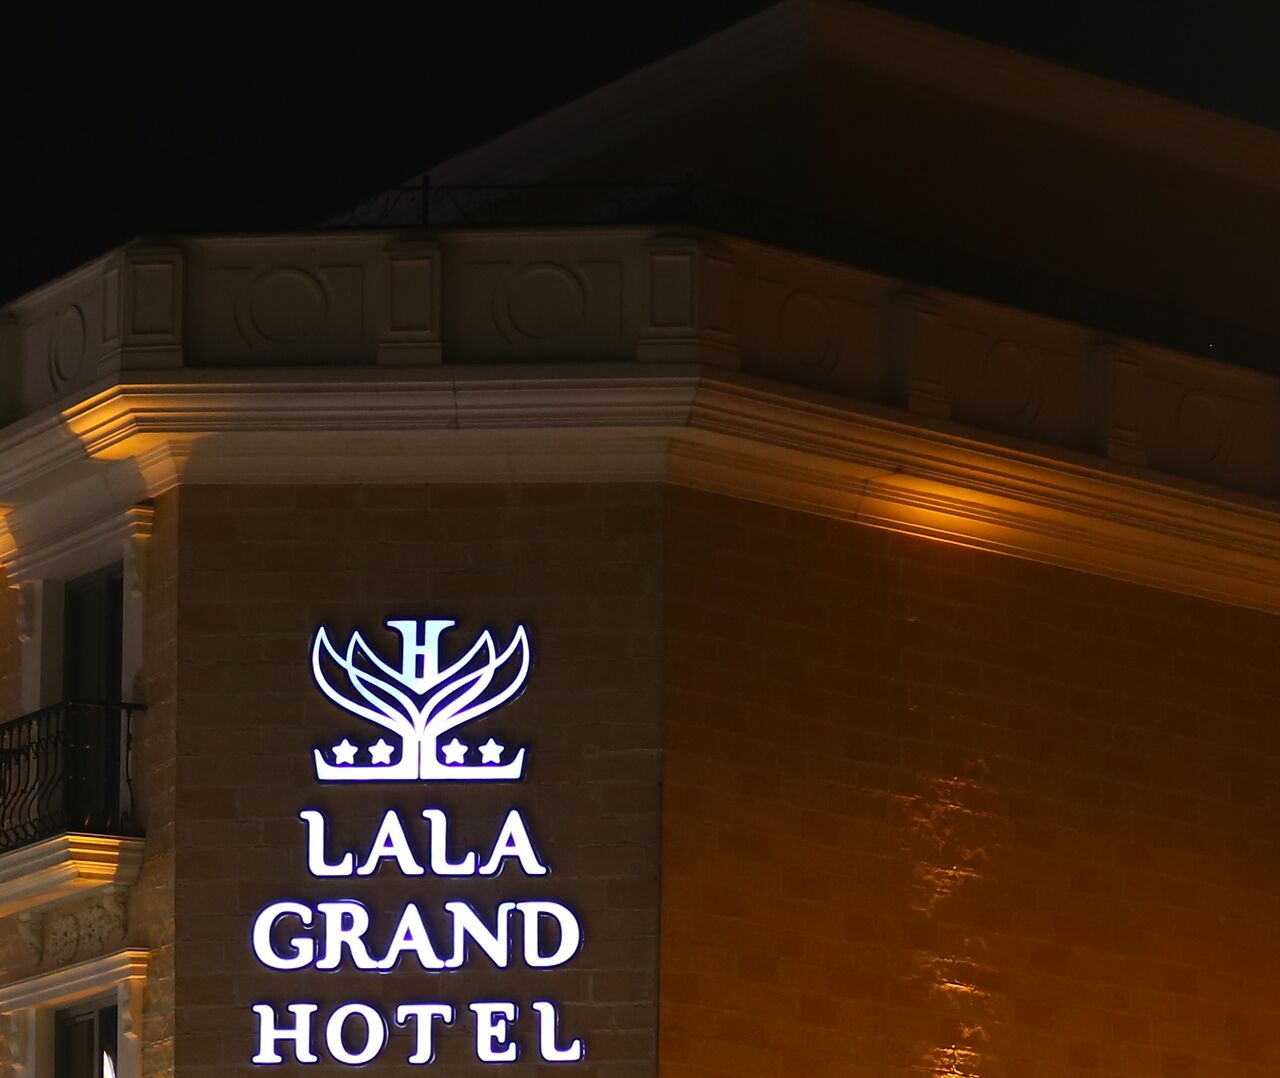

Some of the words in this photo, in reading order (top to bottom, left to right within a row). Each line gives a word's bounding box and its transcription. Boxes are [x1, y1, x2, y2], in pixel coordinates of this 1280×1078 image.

[300, 809, 547, 876] LALA
[252, 901, 581, 970] GRAND
[252, 1001, 582, 1065] HOTEL
